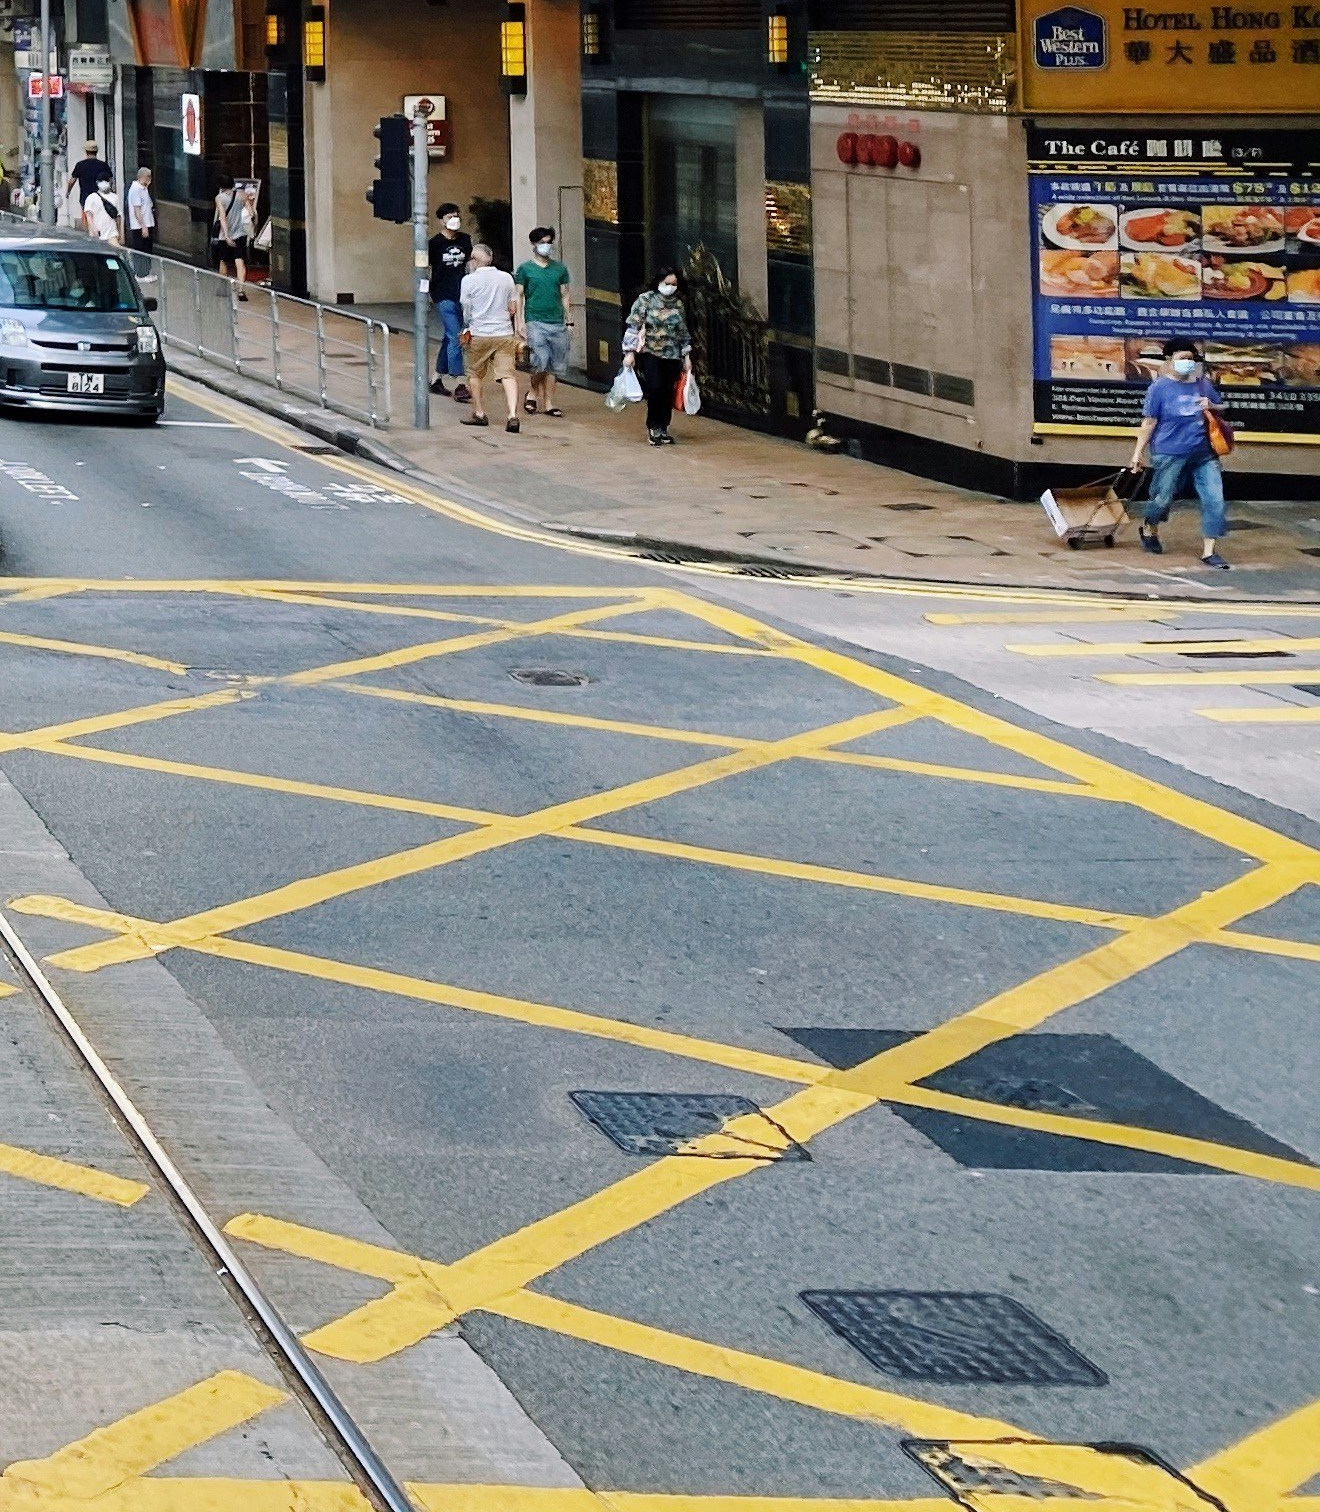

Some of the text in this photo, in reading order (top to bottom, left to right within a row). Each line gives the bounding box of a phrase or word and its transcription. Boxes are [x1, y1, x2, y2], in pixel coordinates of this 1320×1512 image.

[1122, 8, 1202, 31] HOTEL
[1211, 6, 1281, 30] HONG
[1052, 26, 1085, 41] Best
[1040, 38, 1099, 54] Western
[1045, 140, 1085, 155] The
[1090, 139, 1140, 156] Café
